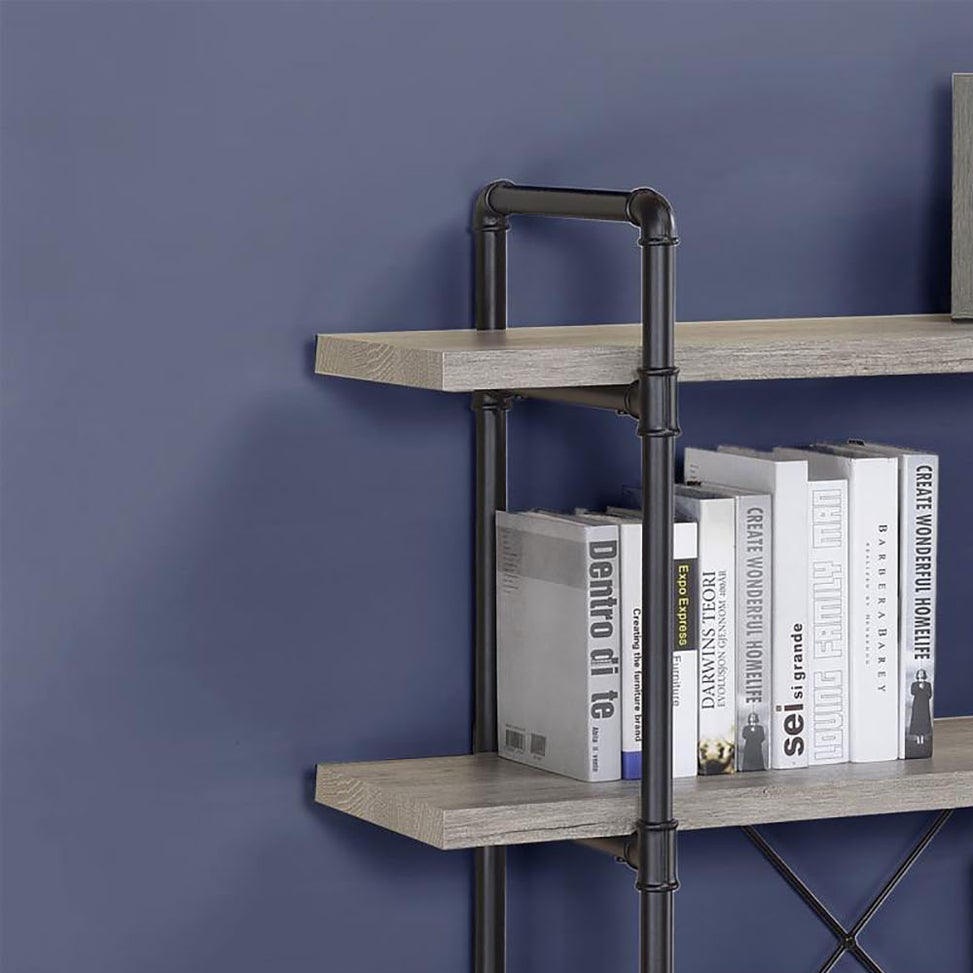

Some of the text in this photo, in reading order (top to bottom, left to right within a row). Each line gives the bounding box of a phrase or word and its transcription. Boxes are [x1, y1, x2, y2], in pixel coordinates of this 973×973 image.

[812, 488, 842, 549] MAN
[914, 465, 933, 660] CREATE WONDERFUL HOMELIFE
[589, 540, 619, 719] Dentro di te
[632, 608, 642, 650] Creating
[677, 565, 689, 646] Expo Express
[701, 571, 716, 709] DARWINS TEORI
[745, 507, 764, 703] CREATE WONDERFUL HOMELIFE
[813, 560, 843, 660] FAMILY
[634, 652, 642, 668] the
[717, 650, 727, 707] EVOLUSJON
[775, 623, 806, 757] sei si grande
[634, 714, 642, 742] brand
